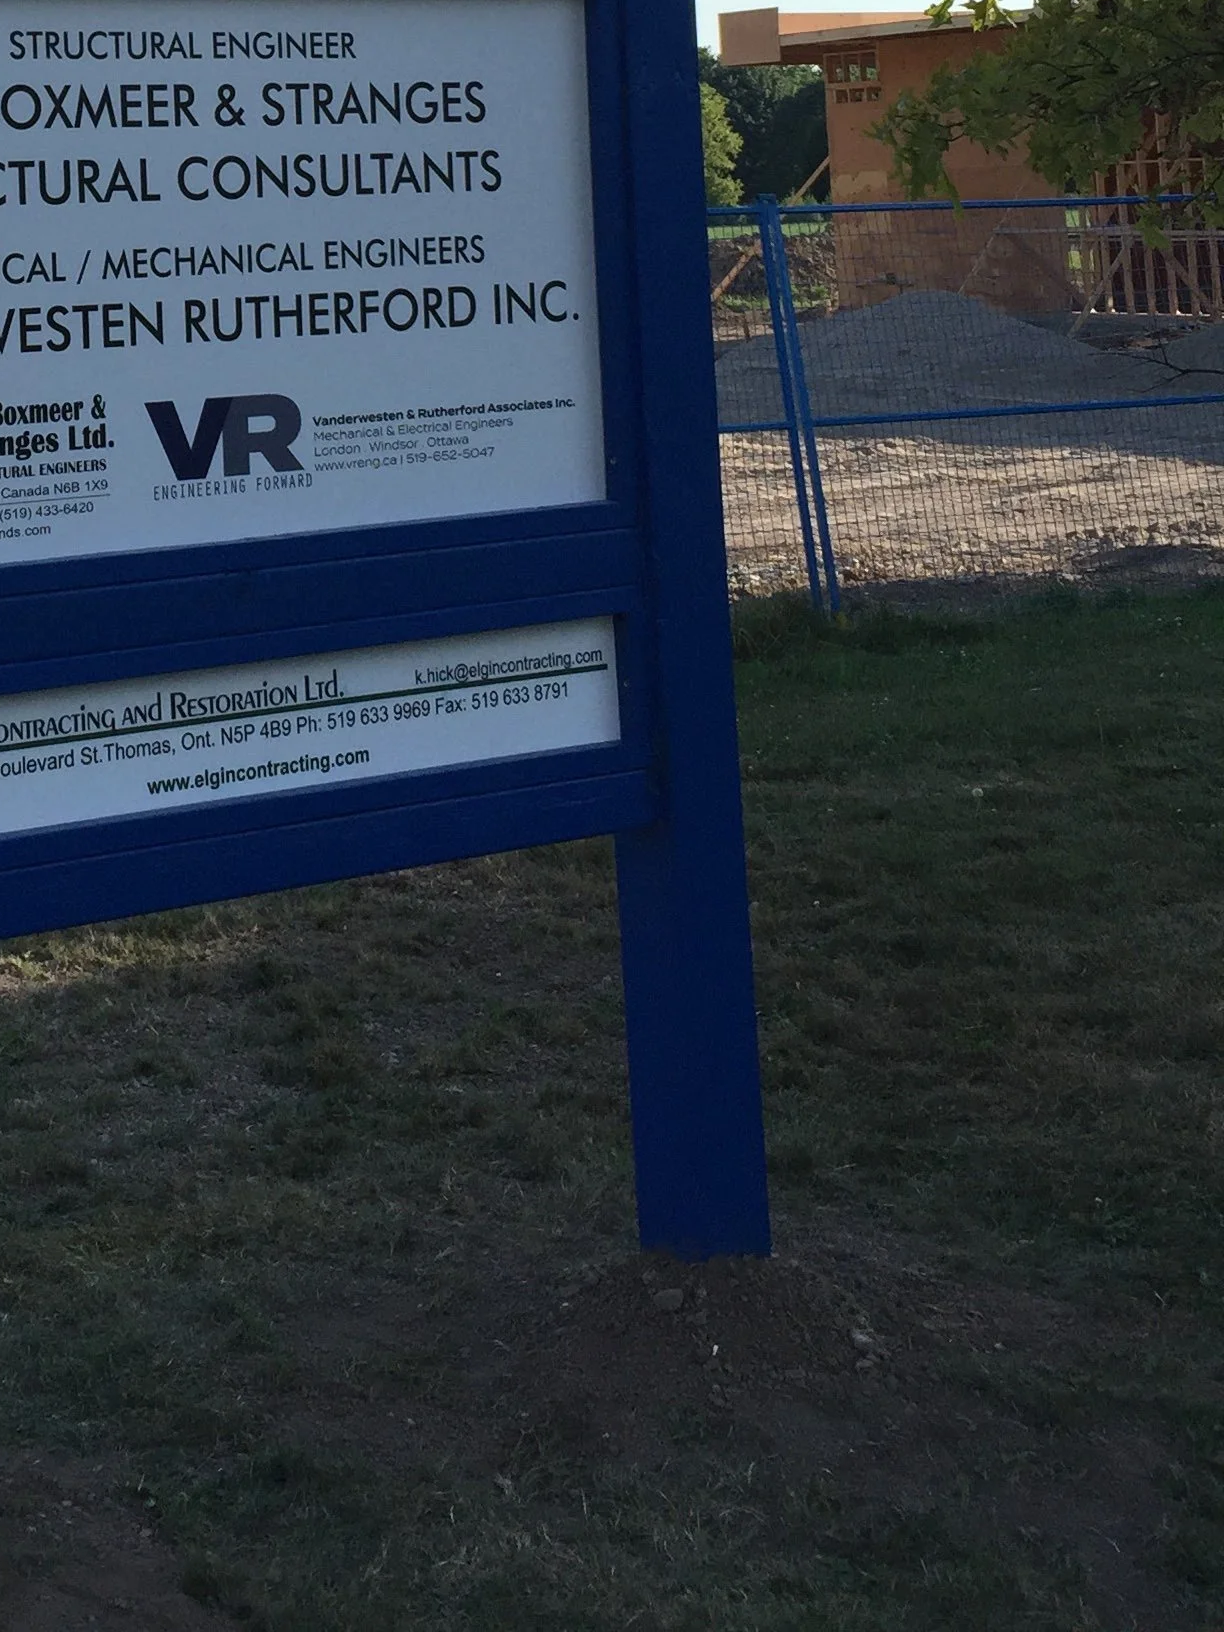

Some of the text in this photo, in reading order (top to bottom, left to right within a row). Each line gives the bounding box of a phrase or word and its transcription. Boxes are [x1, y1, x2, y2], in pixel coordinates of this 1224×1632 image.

[8, 30, 357, 61] STRUCTURAL ENGINEER
[214, 82, 246, 127] &
[262, 80, 487, 127] STRANGES
[177, 149, 502, 201] CONSULTANTS
[102, 241, 314, 281] MECHANICAL
[324, 234, 485, 269] ENGINEERS
[184, 283, 477, 345] RUTHERFORD
[492, 279, 580, 326] INC.
[90, 393, 107, 419] &
[312, 398, 576, 427] Vanderwesten & Rutherford Associates Inc.
[68, 424, 115, 451] Ltd.
[144, 393, 305, 481] VR
[314, 416, 514, 442] Mechanical & Electrical Engineers
[314, 436, 469, 457] London Windsor Ottawa
[406, 446, 495, 464] 519-652-5047
[39, 458, 107, 477] ENGINEERS
[0, 485, 50, 499] Canada
[54, 481, 80, 495] N6B
[84, 479, 108, 491] 1X9
[153, 473, 313, 501] ENGINEERING FORWARD
[0, 507, 32, 523] (519)
[35, 501, 94, 517] 433-6420
[415, 649, 603, 685] k.hick@elgincontracting.com
[181, 731, 215, 751] Ont.
[221, 724, 255, 745] N5P
[260, 718, 291, 739] 4B9
[297, 715, 322, 734] Ph:
[327, 710, 356, 730] 519
[360, 705, 389, 725] 633
[393, 699, 431, 721] 9969
[435, 697, 467, 715] Fax:
[471, 690, 499, 710] 519
[503, 686, 530, 706] 633
[534, 681, 568, 701] 8791
[147, 748, 370, 795] www.elgincontracting.com
